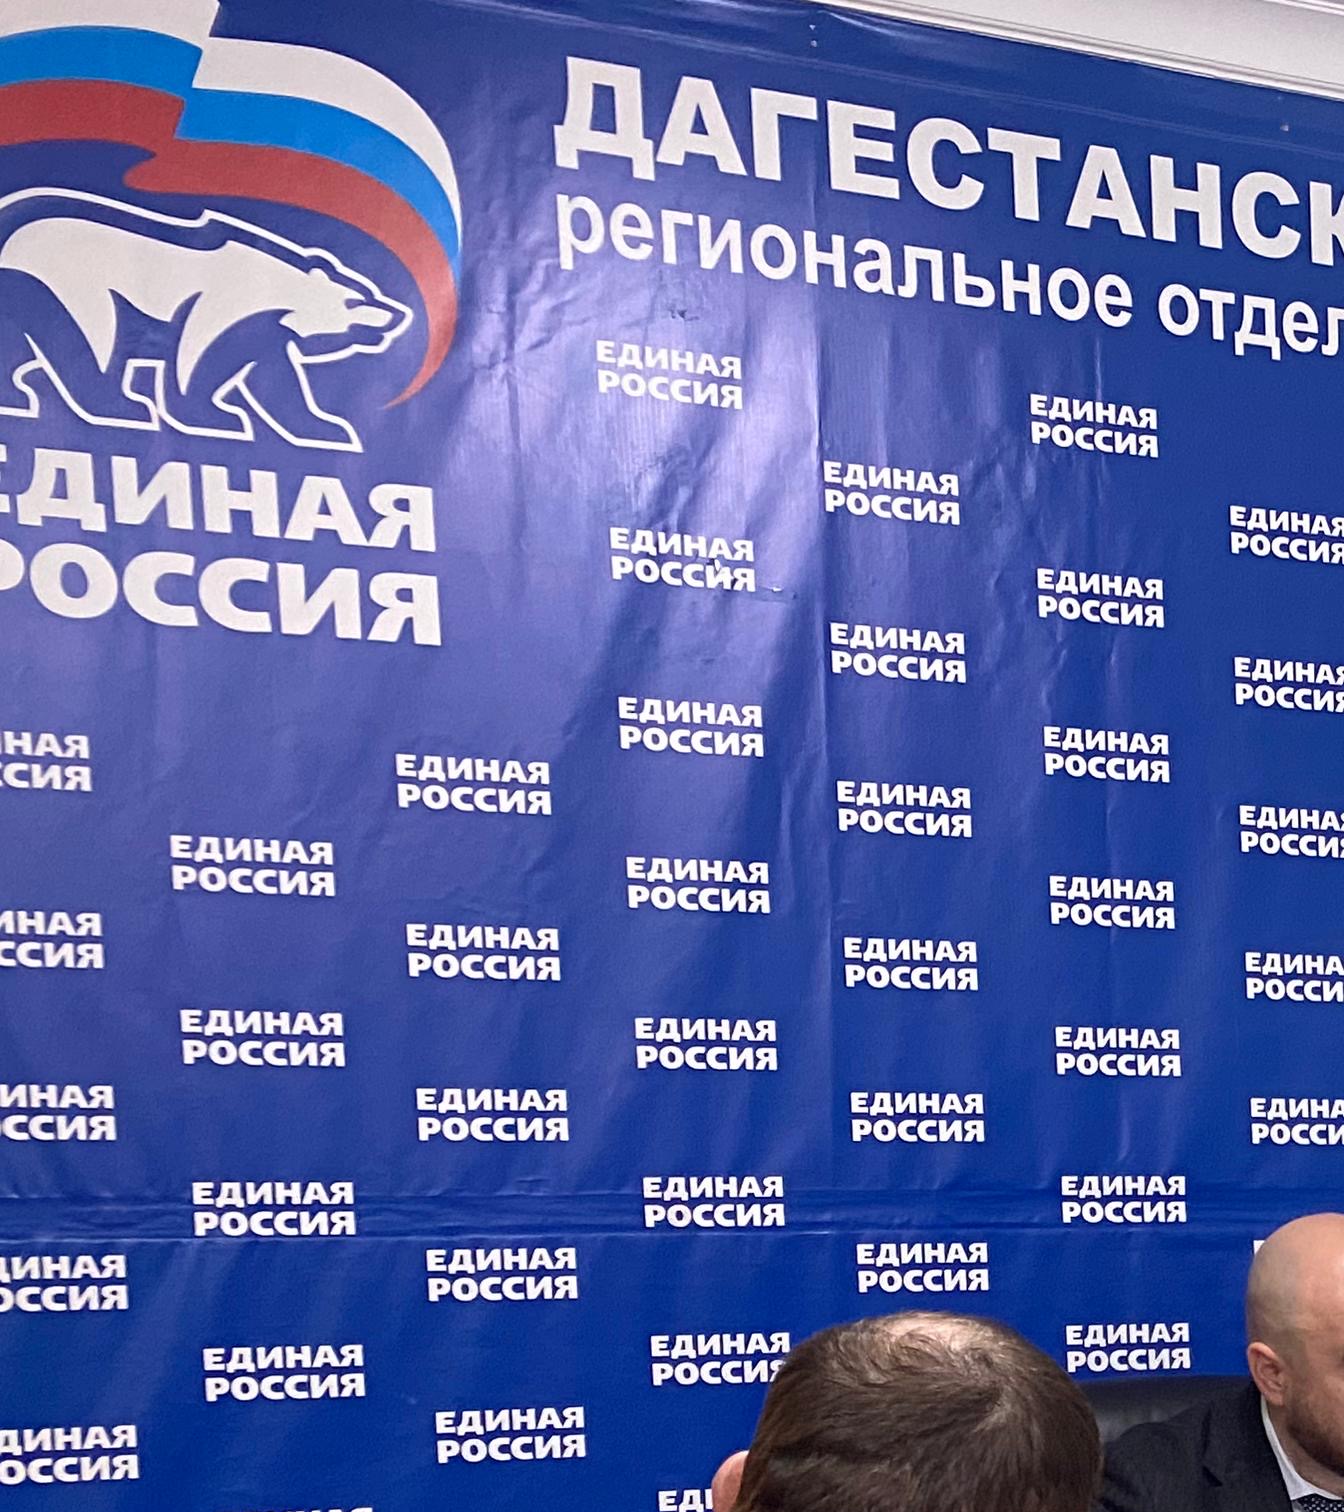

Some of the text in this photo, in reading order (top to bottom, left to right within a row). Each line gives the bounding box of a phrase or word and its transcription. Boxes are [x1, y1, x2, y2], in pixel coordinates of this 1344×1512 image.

[556, 193, 1133, 327] региональное
[596, 340, 742, 379] ЕДИНАЯ
[598, 369, 743, 410] РОССИЯ
[1031, 394, 1157, 429] ЕДИНАЯ
[1032, 422, 1158, 457] РОССИЯ
[823, 460, 959, 496] ЕДИНАЯ
[0, 443, 437, 552] ДИНАЯ
[824, 488, 960, 525] РОССИЯ
[609, 527, 754, 562] ЕДИНАЯ
[611, 556, 755, 592] РОССИЯ
[1038, 568, 1163, 600] ЕДИНАЯ
[1038, 595, 1164, 627] РОССИЯ
[619, 697, 762, 727] ЕДИНАЯ
[620, 725, 763, 757] РОССИЯ
[396, 754, 549, 784] ЕДИНАЯ
[398, 784, 551, 814] РОССИЯ
[837, 781, 970, 808] ЕДИНАЯ
[839, 808, 971, 837] РОССИЯ
[171, 835, 333, 865] ЕДИНАЯ
[172, 865, 335, 896] РОССИЯ
[627, 857, 768, 884] ЕДИНАЯ
[628, 885, 770, 913] РОССИЯ
[1050, 876, 1174, 901] ЕДИНАЯ
[1051, 903, 1175, 929] РОССИЯ
[407, 924, 559, 950] ЕДИНАЯ
[844, 937, 977, 962] ЕДИНАЯ
[408, 953, 560, 980] РОССИЯ
[845, 965, 978, 990] РОССИЯ
[635, 1018, 776, 1042] ЕДИНАЯ
[1056, 1027, 1179, 1050] ЕДИНАЯ
[637, 1046, 777, 1070] РОССИЯ
[1057, 1053, 1181, 1076] РОССИЯ
[416, 1088, 567, 1113] ЕДИНАЯ
[419, 1117, 569, 1141] РОССИЯ
[192, 1182, 353, 1208] ЕДИНАЯ
[643, 1176, 783, 1201] ЕДИНАЯ
[1062, 1176, 1185, 1198] ЕДИНАЯ
[194, 1211, 356, 1236] РОССИЯ
[645, 1204, 785, 1227] РОССИЯ
[1062, 1201, 1186, 1223] РОССИЯ
[857, 1243, 987, 1267] ЕДИНАЯ
[858, 1269, 989, 1292] РОССИЯ
[1066, 1323, 1189, 1347] ЕДИНАЯ
[203, 1345, 363, 1373] ЕДИНАЯ
[1067, 1348, 1190, 1372] РОССИЯ
[206, 1373, 365, 1401] РОССИЯ
[436, 1407, 584, 1435] ЕДИНАЯ
[437, 1435, 586, 1463] РОССИЯ
